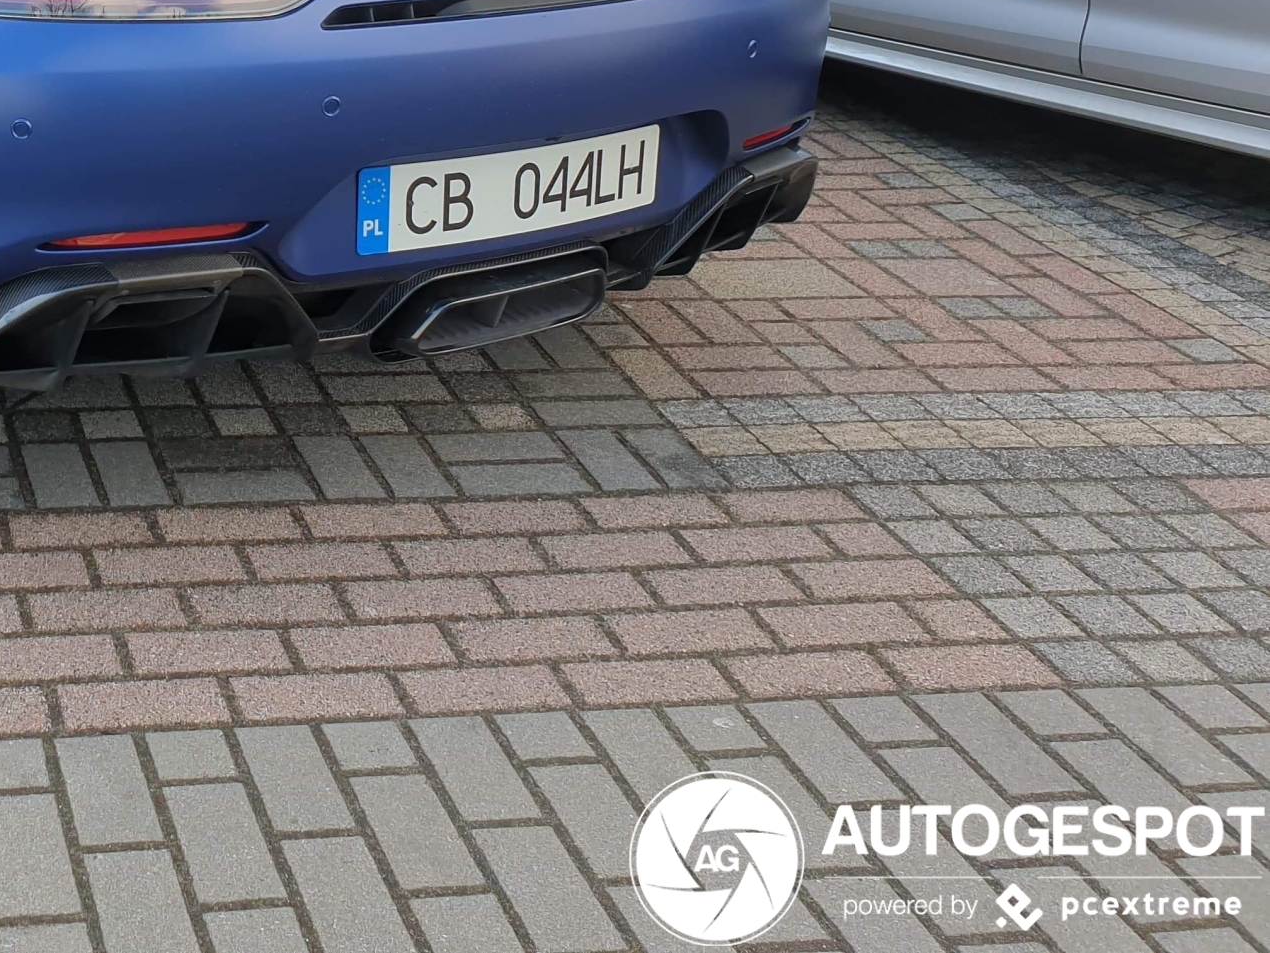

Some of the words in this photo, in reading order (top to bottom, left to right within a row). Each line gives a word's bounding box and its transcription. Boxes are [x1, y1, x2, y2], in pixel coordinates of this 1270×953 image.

[406, 173, 473, 234] CB
[513, 139, 645, 219] 044LH
[363, 219, 384, 237] PL
